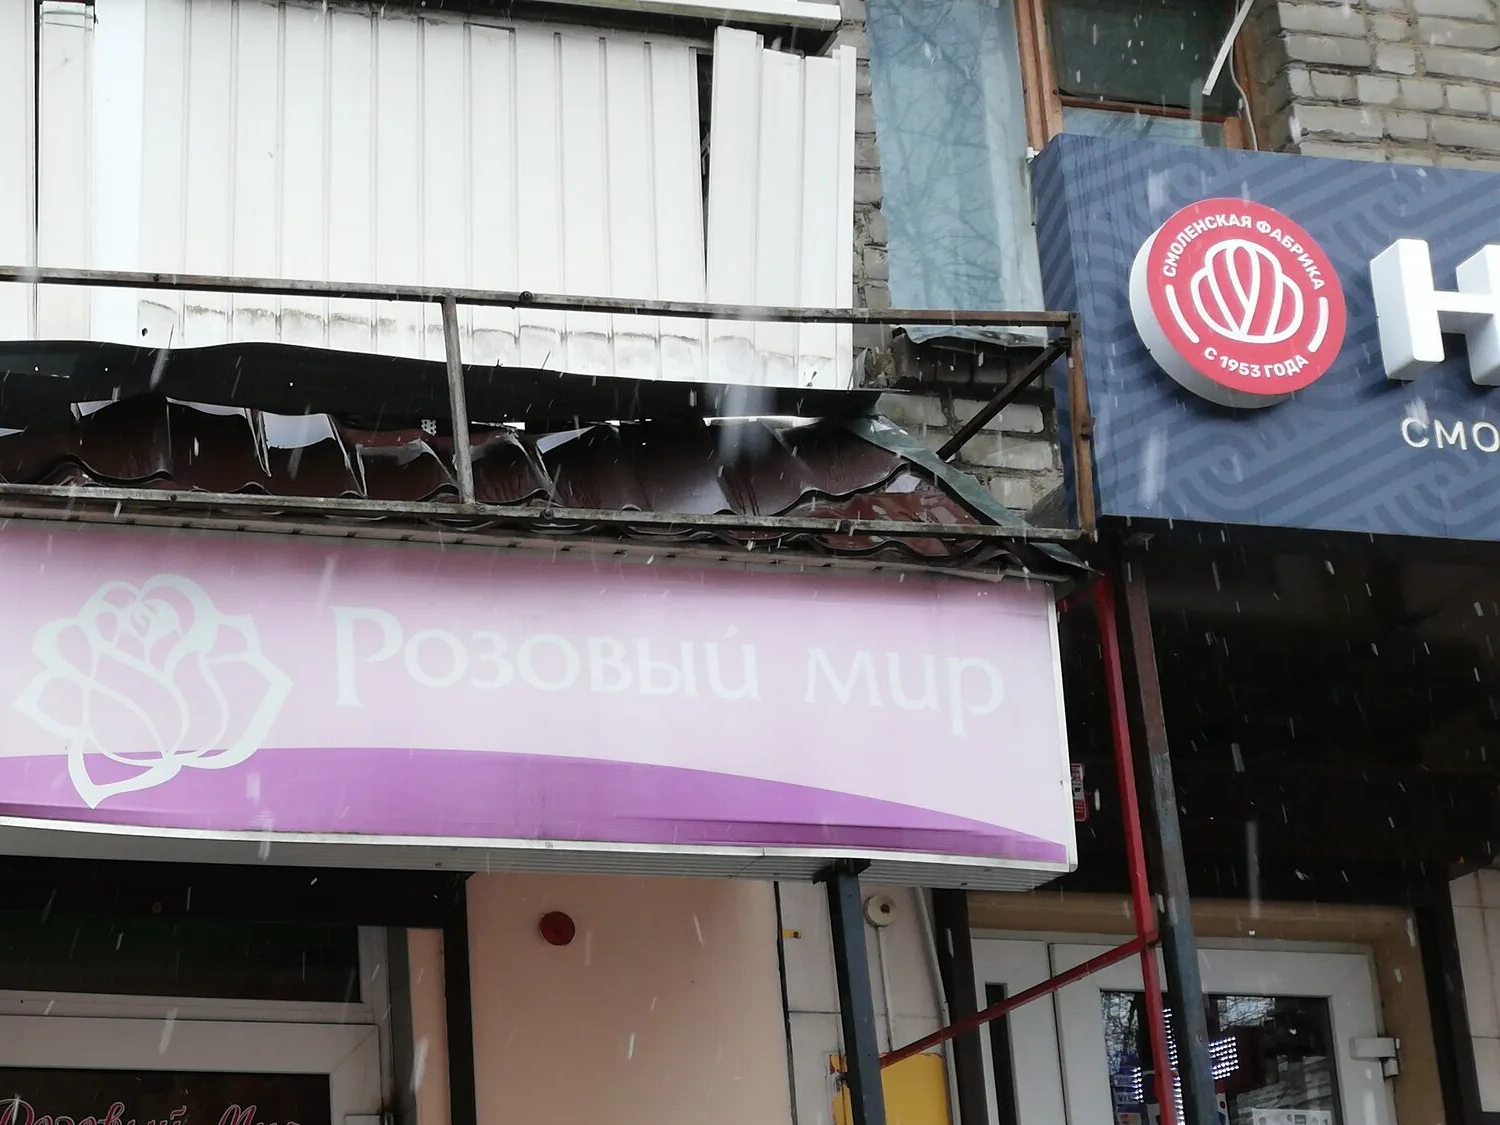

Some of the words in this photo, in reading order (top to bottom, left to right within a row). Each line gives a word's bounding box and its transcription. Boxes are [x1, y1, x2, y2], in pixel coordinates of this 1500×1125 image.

[1162, 213, 1253, 279] СМОЛЕНСКАЯ
[1255, 220, 1327, 291] ФАБРИКА
[1203, 346, 1218, 361] С
[1219, 355, 1261, 378] 1953
[1264, 354, 1310, 379] ГОДА
[1401, 416, 1500, 453] СМО
[329, 604, 762, 709] Розовый
[804, 646, 1006, 738] мир
